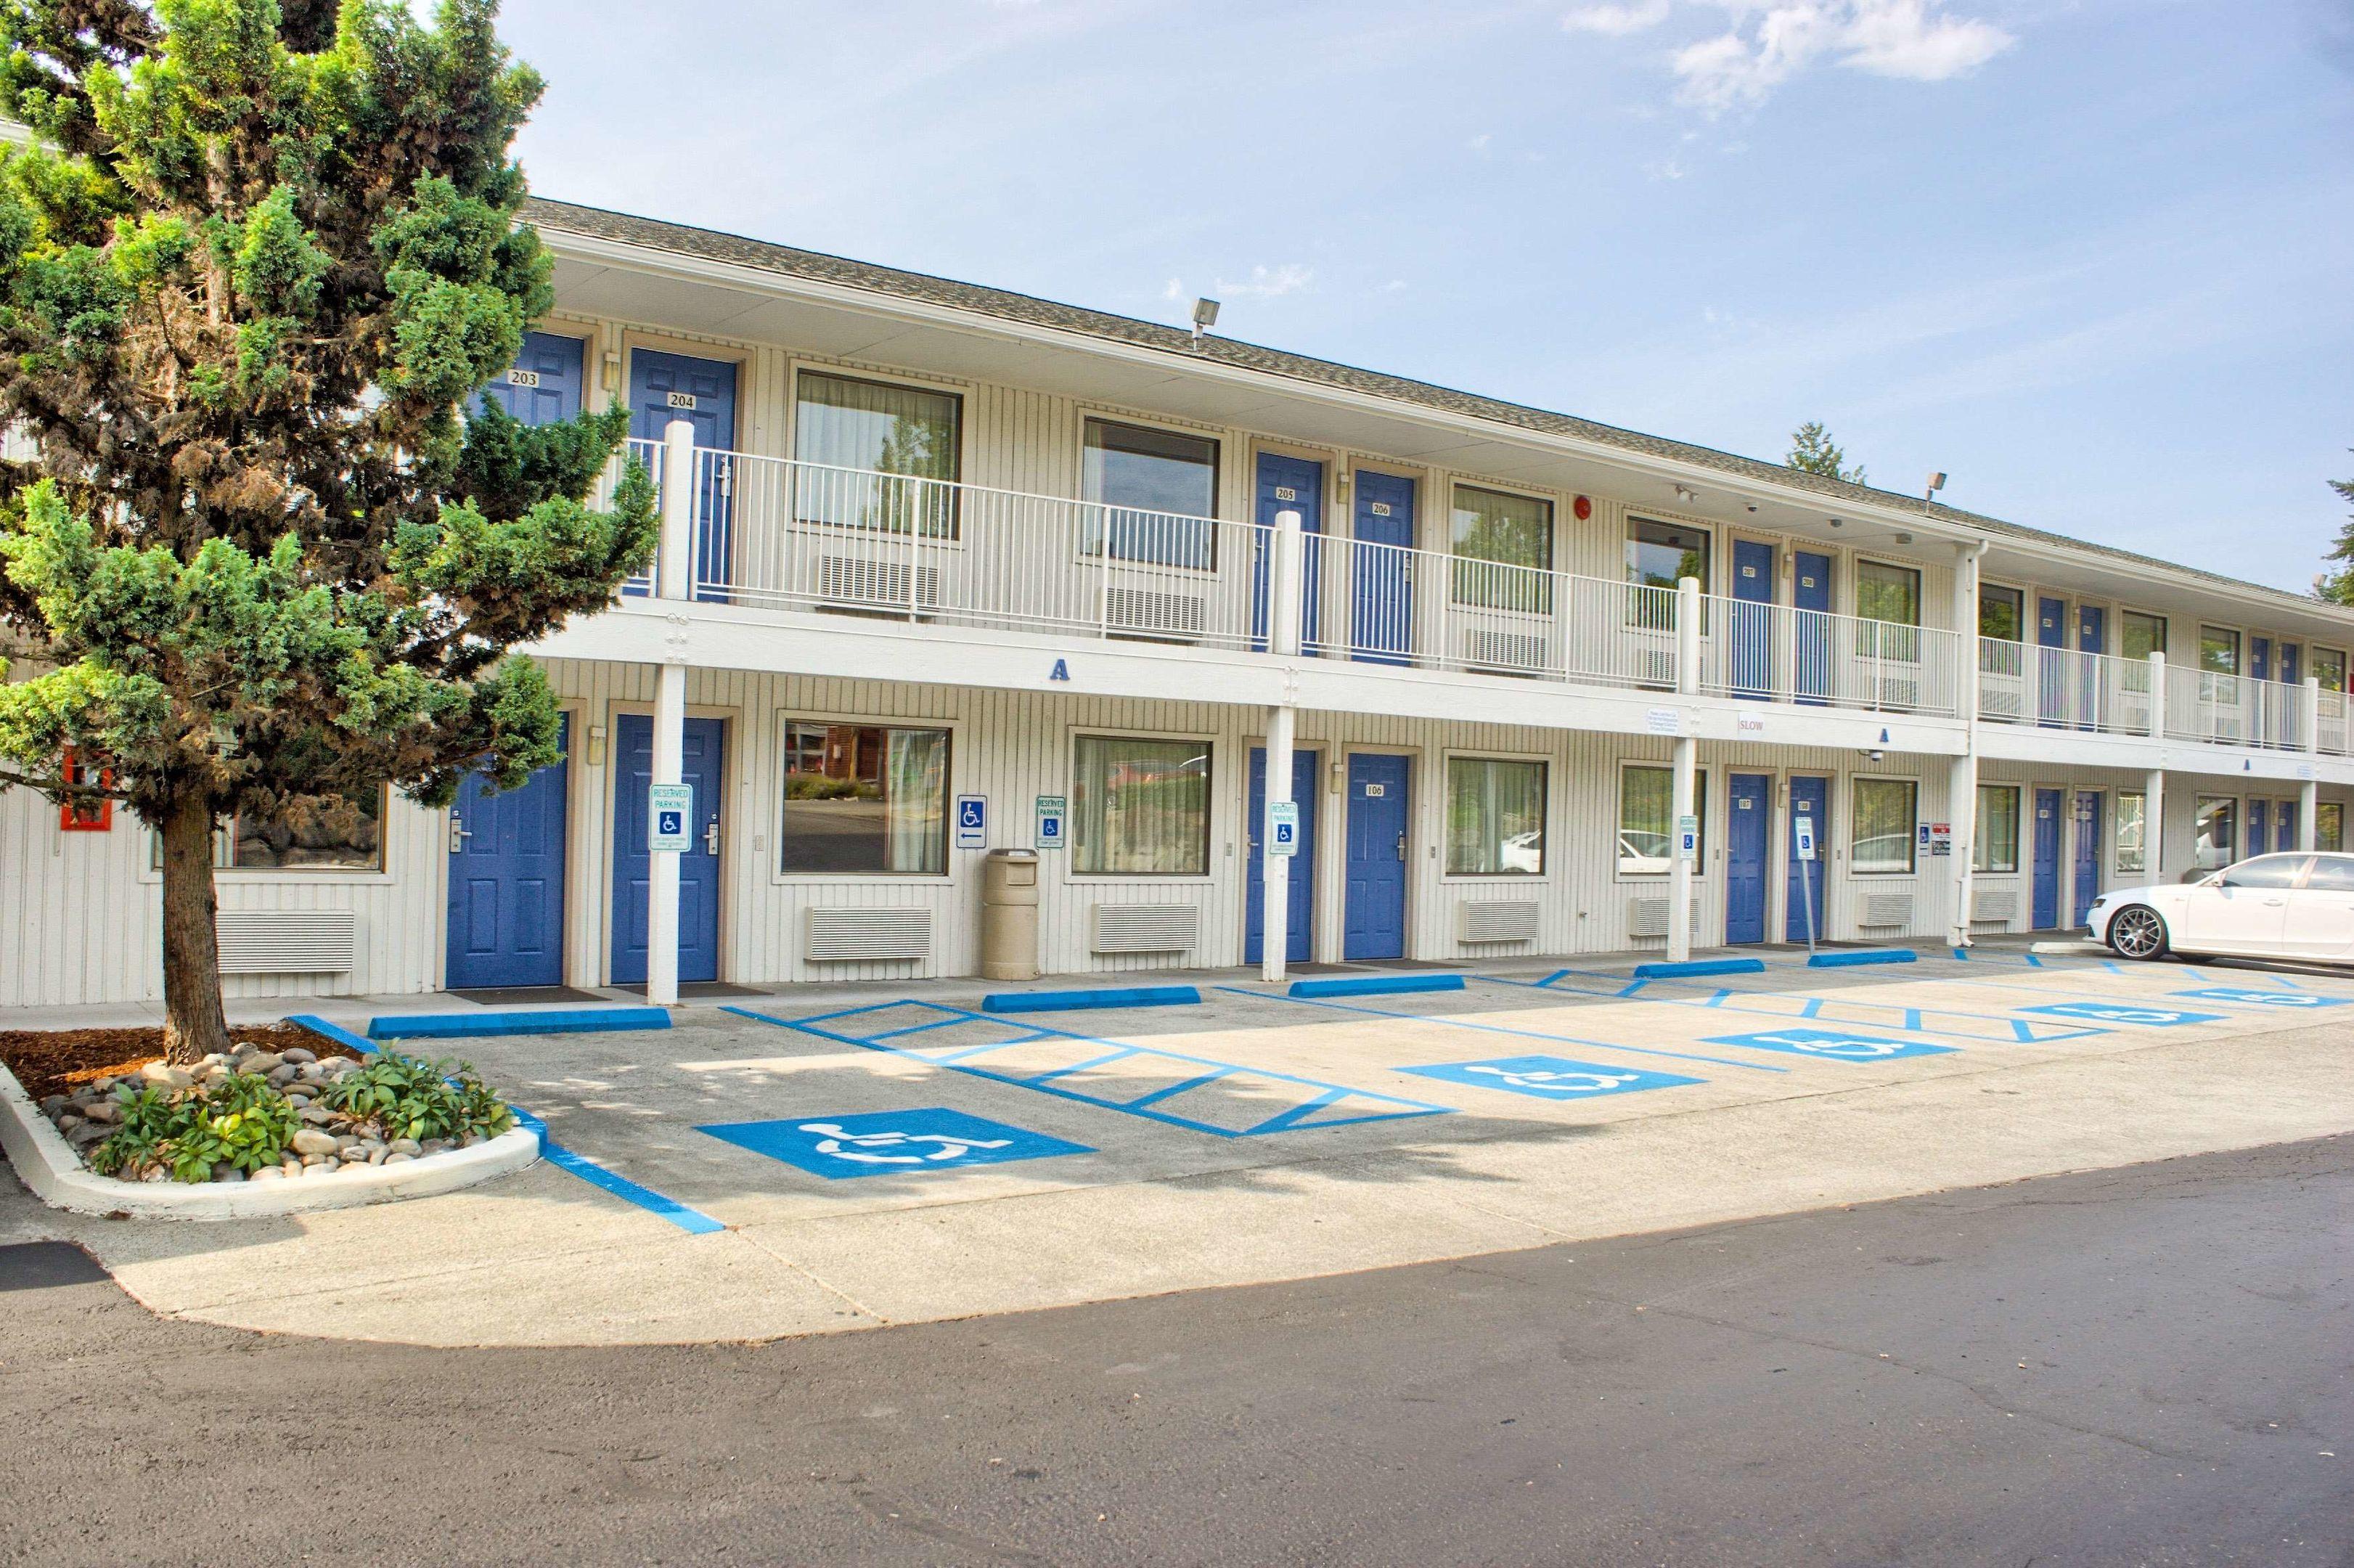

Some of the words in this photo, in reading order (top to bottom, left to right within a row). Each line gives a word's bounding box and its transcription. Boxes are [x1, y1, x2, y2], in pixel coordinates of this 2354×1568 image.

[512, 372, 536, 385] 203
[671, 394, 693, 407] 204
[1278, 489, 1294, 499] 205
[1374, 505, 1388, 515] 206
[1050, 658, 1071, 681] A
[1740, 720, 1764, 731] SLOW
[1879, 728, 1889, 743] A
[654, 788, 688, 797] RESERVED
[1368, 786, 1381, 795] 106
[655, 801, 686, 809] PARKING
